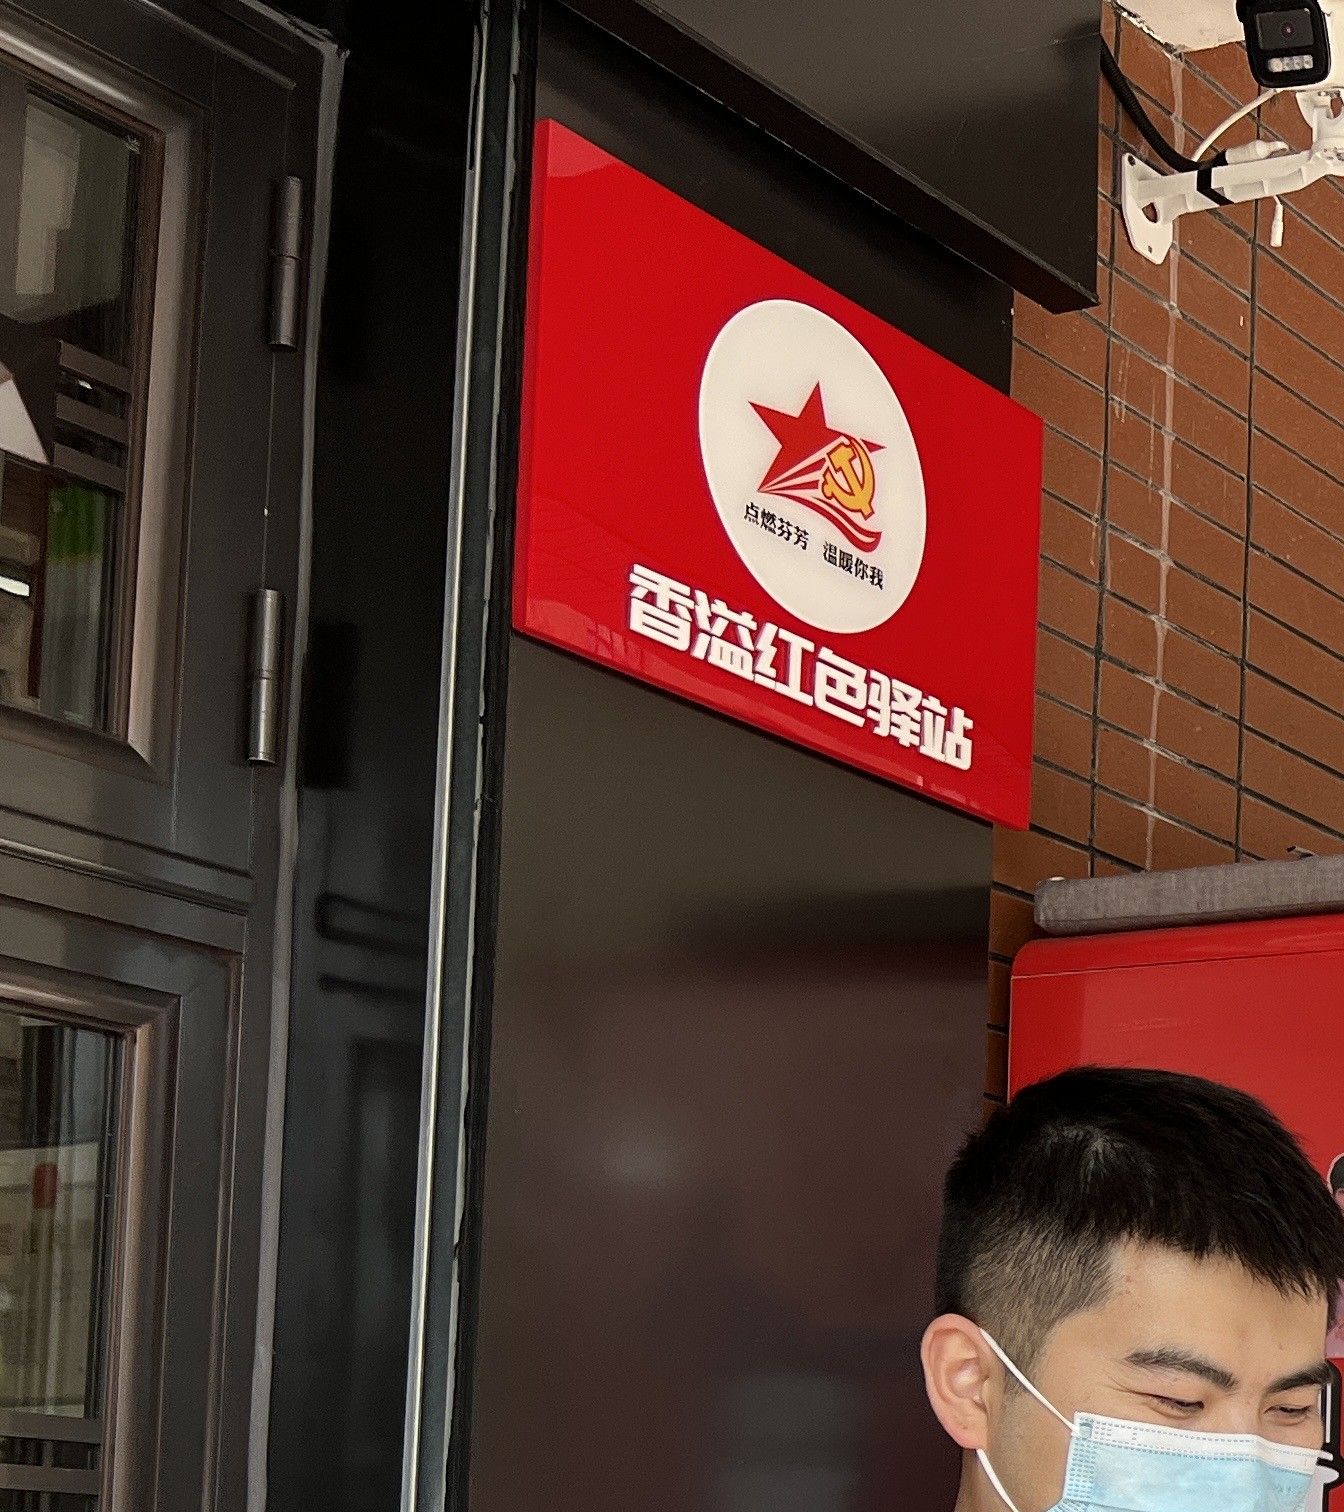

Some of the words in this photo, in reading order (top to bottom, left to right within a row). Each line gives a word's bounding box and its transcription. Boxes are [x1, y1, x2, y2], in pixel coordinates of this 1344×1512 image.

[744, 502, 809, 550] 点燃芬芳
[823, 541, 883, 590] 温暖你我
[629, 563, 973, 770] 香溢红色驿站
